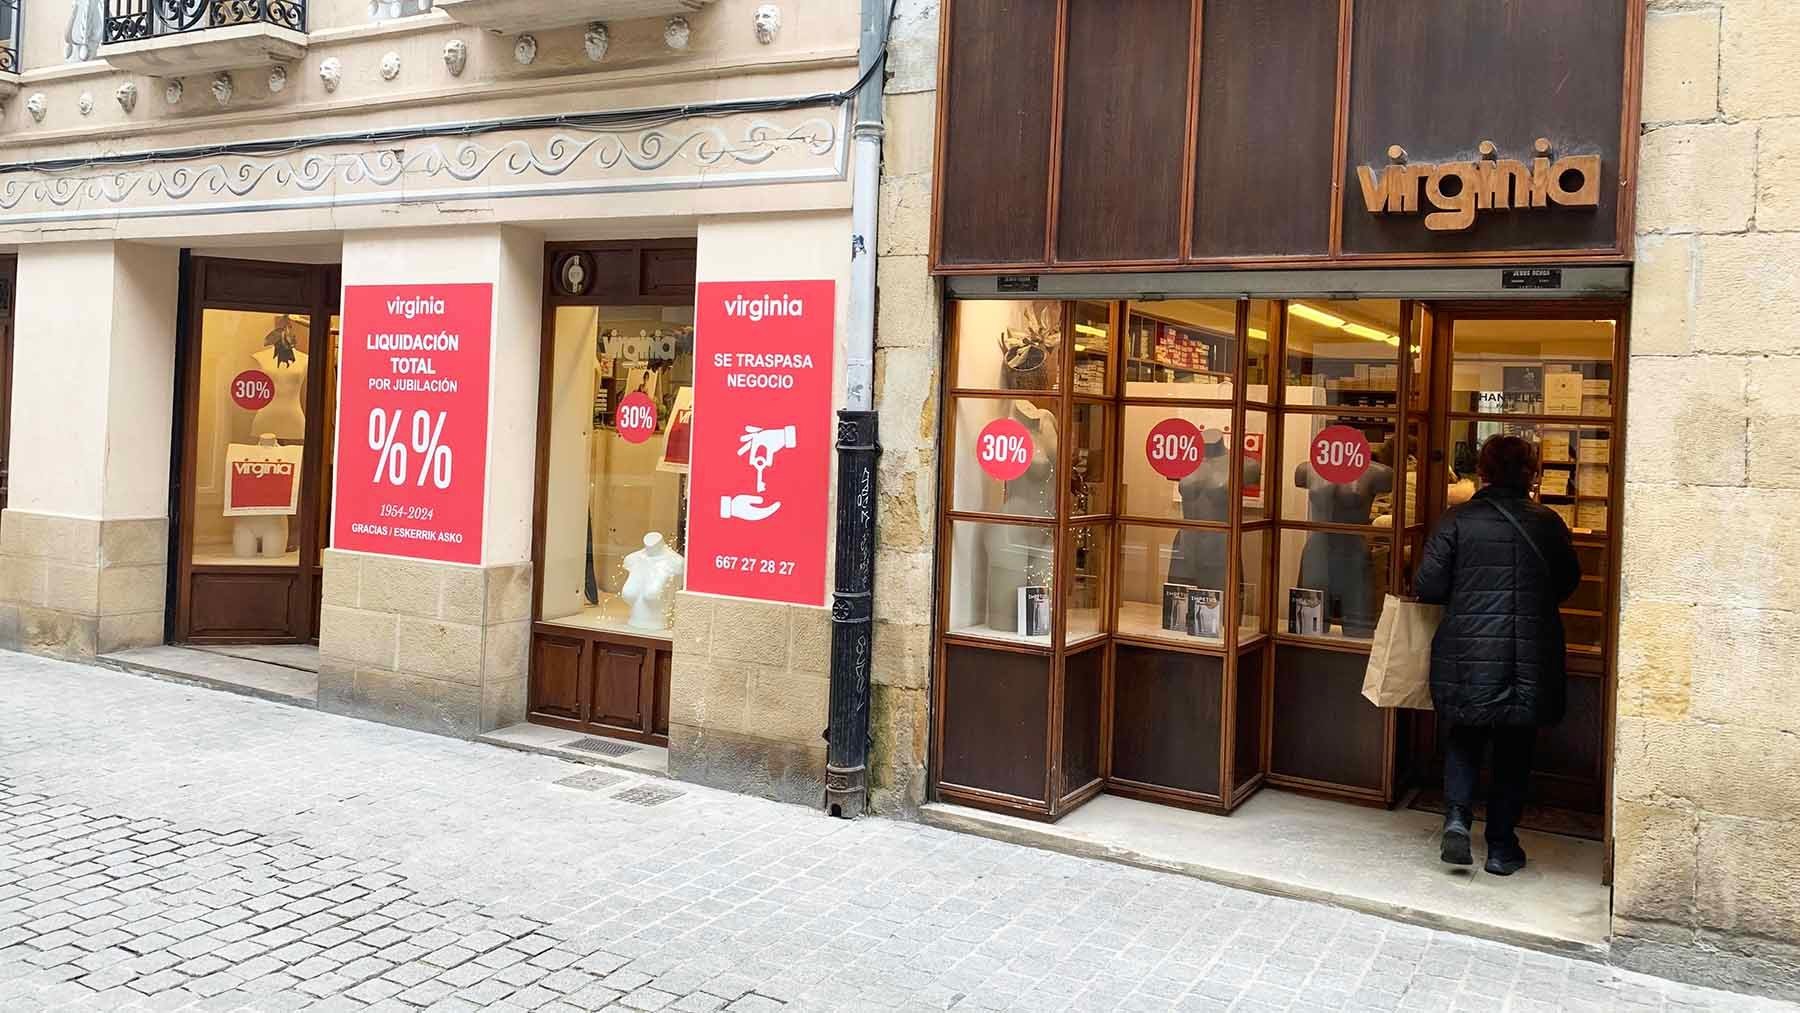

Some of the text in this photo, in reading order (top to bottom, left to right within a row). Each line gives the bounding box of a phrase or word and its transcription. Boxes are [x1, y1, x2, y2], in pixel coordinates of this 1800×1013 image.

[1356, 137, 1602, 230] virginia
[386, 295, 445, 319] virginia
[725, 294, 803, 321] virginia
[366, 331, 459, 351] LIQUIDACIÓN
[390, 357, 437, 375] TOTAL
[713, 353, 814, 369] SE TRASPASA
[235, 380, 271, 399] 30%
[368, 377, 458, 393] POR JUBILACIÓN
[728, 374, 794, 389] NEGOCIO
[620, 405, 653, 430] 30%
[982, 434, 1027, 463] 30%
[1151, 434, 1198, 462] 30%
[1316, 440, 1364, 468] 30%
[234, 458, 292, 478] virginia
[379, 504, 434, 521] 1954-2024
[351, 523, 388, 536] GRACIAS
[393, 527, 437, 541] ESKERRIK
[437, 531, 463, 543] ASKO
[715, 555, 796, 576] 667 27 28 27
